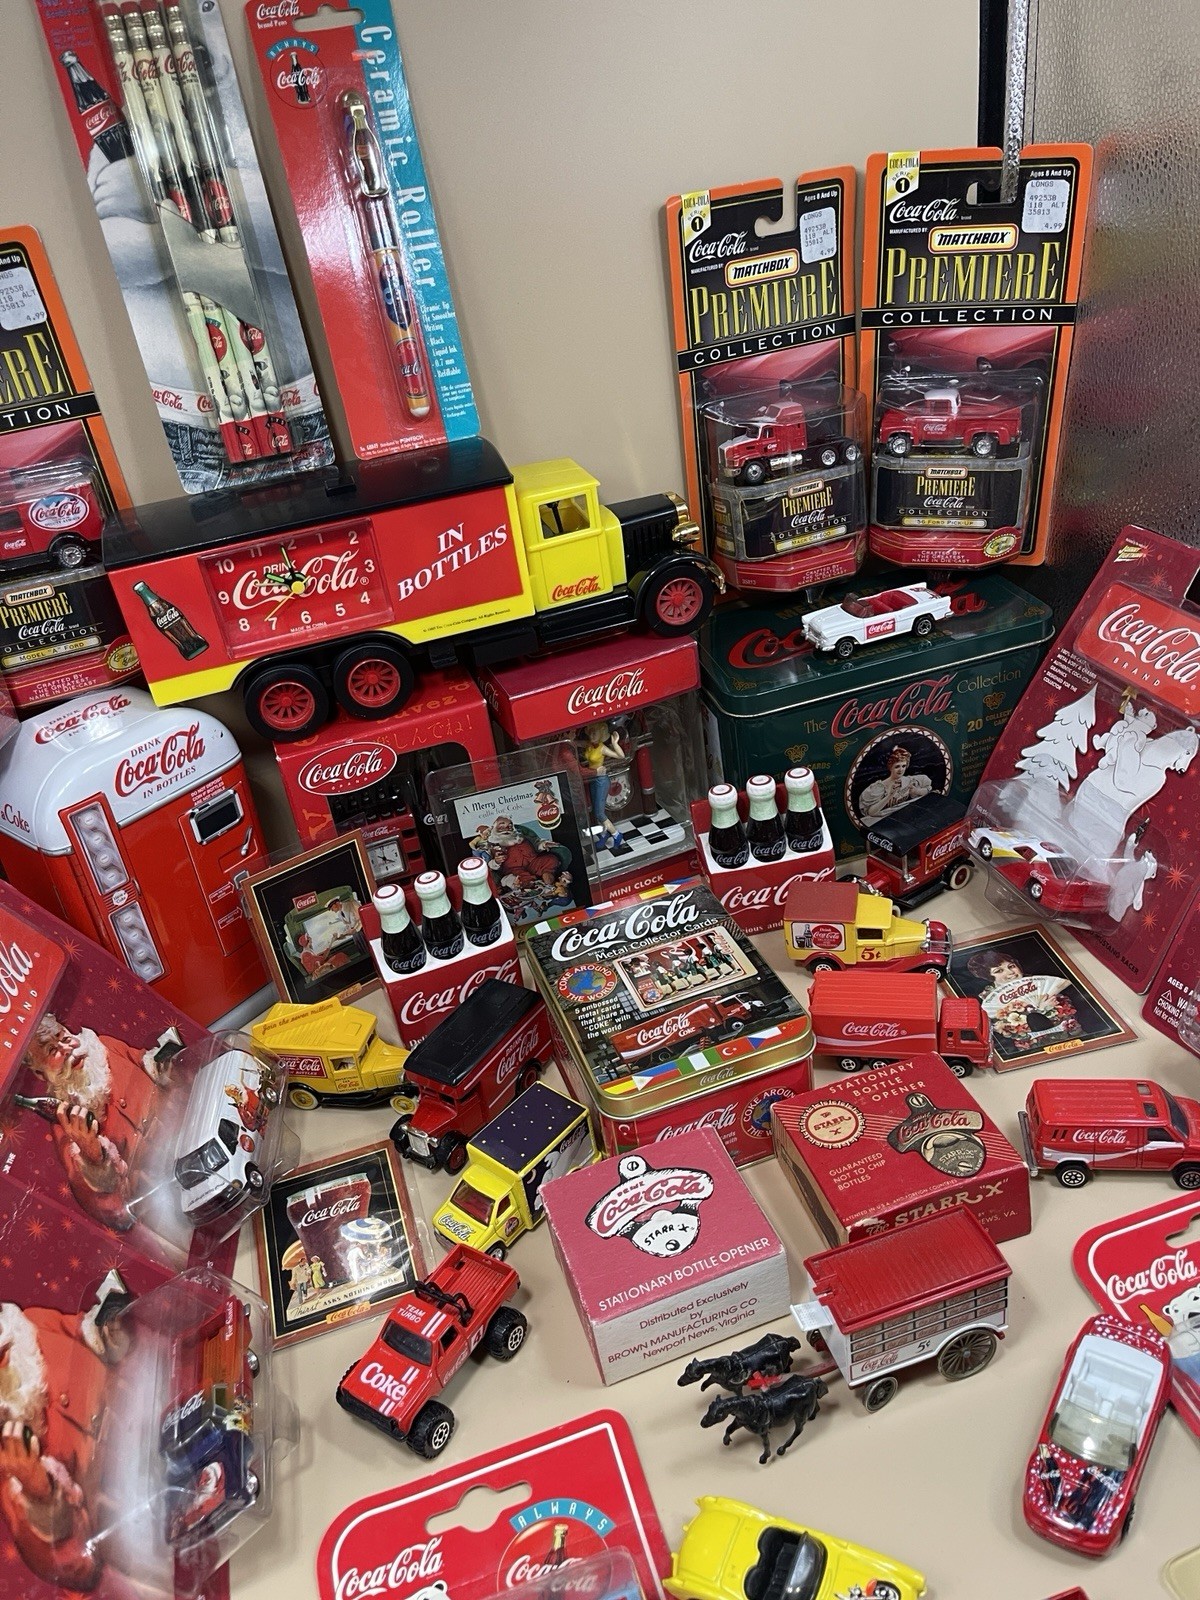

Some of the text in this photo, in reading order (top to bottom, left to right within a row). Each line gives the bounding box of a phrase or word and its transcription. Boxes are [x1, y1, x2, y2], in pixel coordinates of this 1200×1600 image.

[256, 0, 300, 19] Coca-Cola
[269, 39, 318, 58] ALWAYS
[277, 67, 322, 89] Coca-Cola
[361, 25, 412, 168] Ceramic
[892, 171, 914, 181] SERIES
[1030, 168, 1072, 178] Ages And Up
[899, 180, 906, 191] 1
[1030, 180, 1054, 188] LONGS
[889, 198, 961, 224] Coca-Cola
[1051, 201, 1065, 209] ALT
[687, 210, 708, 222] SERIES
[694, 218, 701, 230] 1
[803, 211, 823, 221] LONGS
[1044, 222, 1063, 230] 4.99
[396, 185, 438, 288] Roller
[823, 227, 834, 236] ALT
[936, 231, 1010, 247] MATCHBOX
[689, 230, 749, 264] Coca-Cola
[820, 247, 834, 256] 4.99
[11, 254, 21, 263] Up
[732, 257, 793, 280] MATCHBOX
[883, 242, 1061, 305] PREMIERE
[22, 289, 37, 299] ALT
[690, 260, 837, 345] PREMIERE
[26, 311, 46, 322] 4.99
[881, 308, 1053, 325] COLLECTION
[694, 323, 837, 364] COLLECTION
[929, 468, 964, 476] MATCHBOX
[916, 476, 976, 497] PREMIERE
[35, 501, 82, 521] Coca-Cola
[781, 486, 834, 518] PREMIERE
[923, 495, 965, 508] Coca-Cola
[791, 508, 826, 529] Coca-Cola
[898, 509, 989, 517] COLLECTION
[316, 532, 323, 544] 1
[348, 531, 359, 545] 2
[437, 523, 465, 554] IN
[771, 516, 848, 541] COLLECTION
[250, 544, 264, 558] 11
[215, 558, 235, 576] 10
[263, 559, 298, 576] DRINK
[364, 559, 375, 573] 3
[397, 524, 508, 601] BOTTLES
[9, 586, 49, 603] MATCHBOX
[217, 591, 230, 605] 9
[360, 591, 371, 605] 4
[552, 575, 600, 601] Coca-Cola
[0, 591, 73, 630] PREMIERE
[156, 607, 181, 629] Coca-Cola
[301, 610, 312, 624] 6
[335, 602, 347, 617] 5
[18, 616, 65, 641] Coca-Cola
[238, 617, 250, 632] 8
[268, 616, 279, 631] 7
[868, 620, 896, 636] Coca-Cola
[20, 641, 85, 662] MODEL FORD
[1098, 603, 1200, 684] Coca-Cola
[957, 668, 1021, 694] Collection
[1113, 657, 1161, 687] BRAND
[29, 680, 97, 701] NAME DIE-CAST
[36, 677, 71, 690] CRAFTED
[567, 667, 647, 715] Coca-Cola
[831, 671, 958, 739] Coca-Cola
[35, 694, 132, 745] Coca-Cola
[804, 718, 827, 734] The
[967, 718, 984, 733] 20
[130, 737, 162, 758] DRINK
[115, 721, 206, 797] Coca-Cola
[305, 747, 385, 790] Coca-Cola
[143, 765, 197, 799] IN BOTTLES
[471, 791, 534, 815] Merry Christmas
[4, 804, 31, 833] Coke
[867, 831, 893, 852] Coca-Cola
[609, 874, 664, 899] MINI CLOCK
[551, 891, 702, 962] Coca-Cola
[595, 916, 720, 962] Metal Collector Cards
[1120, 956, 1139, 975] RACER
[559, 964, 615, 1002] COKE AROUND THE WORLD
[999, 981, 1038, 1004] Coca-Cola
[1167, 976, 1184, 991] AGES
[578, 1003, 621, 1021] metal cards
[581, 996, 619, 1013] embossed
[1157, 998, 1180, 1018] CHOKING
[4, 989, 38, 1049] BRAND
[262, 1003, 334, 1036] Join the million
[581, 1017, 597, 1027] that
[597, 1011, 618, 1022] share
[615, 1013, 631, 1024] with
[841, 1021, 902, 1037] Coca-Cola
[587, 1023, 622, 1040] the world
[637, 1012, 696, 1047] Coca-Cola
[678, 1026, 697, 1038] Coke
[496, 1025, 540, 1086] Coca-Cola
[700, 1066, 735, 1087] Coca-Cola
[829, 1061, 915, 1094] STATIONARY
[853, 1077, 904, 1098] BOTTLE
[871, 1080, 926, 1103] OPENER
[743, 1097, 763, 1137] COKE THE
[813, 1115, 852, 1131] STARR
[897, 1110, 971, 1145] Coca-Cola
[1072, 1128, 1128, 1144] Coca-Cola
[829, 1152, 883, 1176] GUARANTEED
[833, 1159, 886, 1184] NOT TO CHIP
[616, 1180, 646, 1197] DRINK
[838, 1175, 872, 1191] BOTTLES
[298, 1193, 362, 1229] Coca-Cola
[596, 1173, 706, 1234] Coca-Cola
[894, 1190, 984, 1228] STARR
[1003, 1210, 1018, 1218] VA.
[438, 1213, 478, 1243] Coca-Cola
[643, 1224, 675, 1247] STARR
[598, 1237, 771, 1312] STATIONARY BOTTLE OPENER
[1106, 1248, 1197, 1304] Coca-Cola
[330, 1301, 369, 1322] Coca-Cola
[397, 1307, 422, 1324] TURBO
[406, 1303, 426, 1317] TEAM
[639, 1280, 750, 1330] Distributed Exclusively
[689, 1309, 705, 1322] by
[607, 1297, 760, 1364] BROWN MANUFACTURING CO.
[642, 1308, 756, 1360] Newport News, Virginia
[360, 1362, 408, 1401] Coke
[518, 1502, 607, 1531] ALWAYS
[336, 1537, 444, 1600] Coca-Cola
